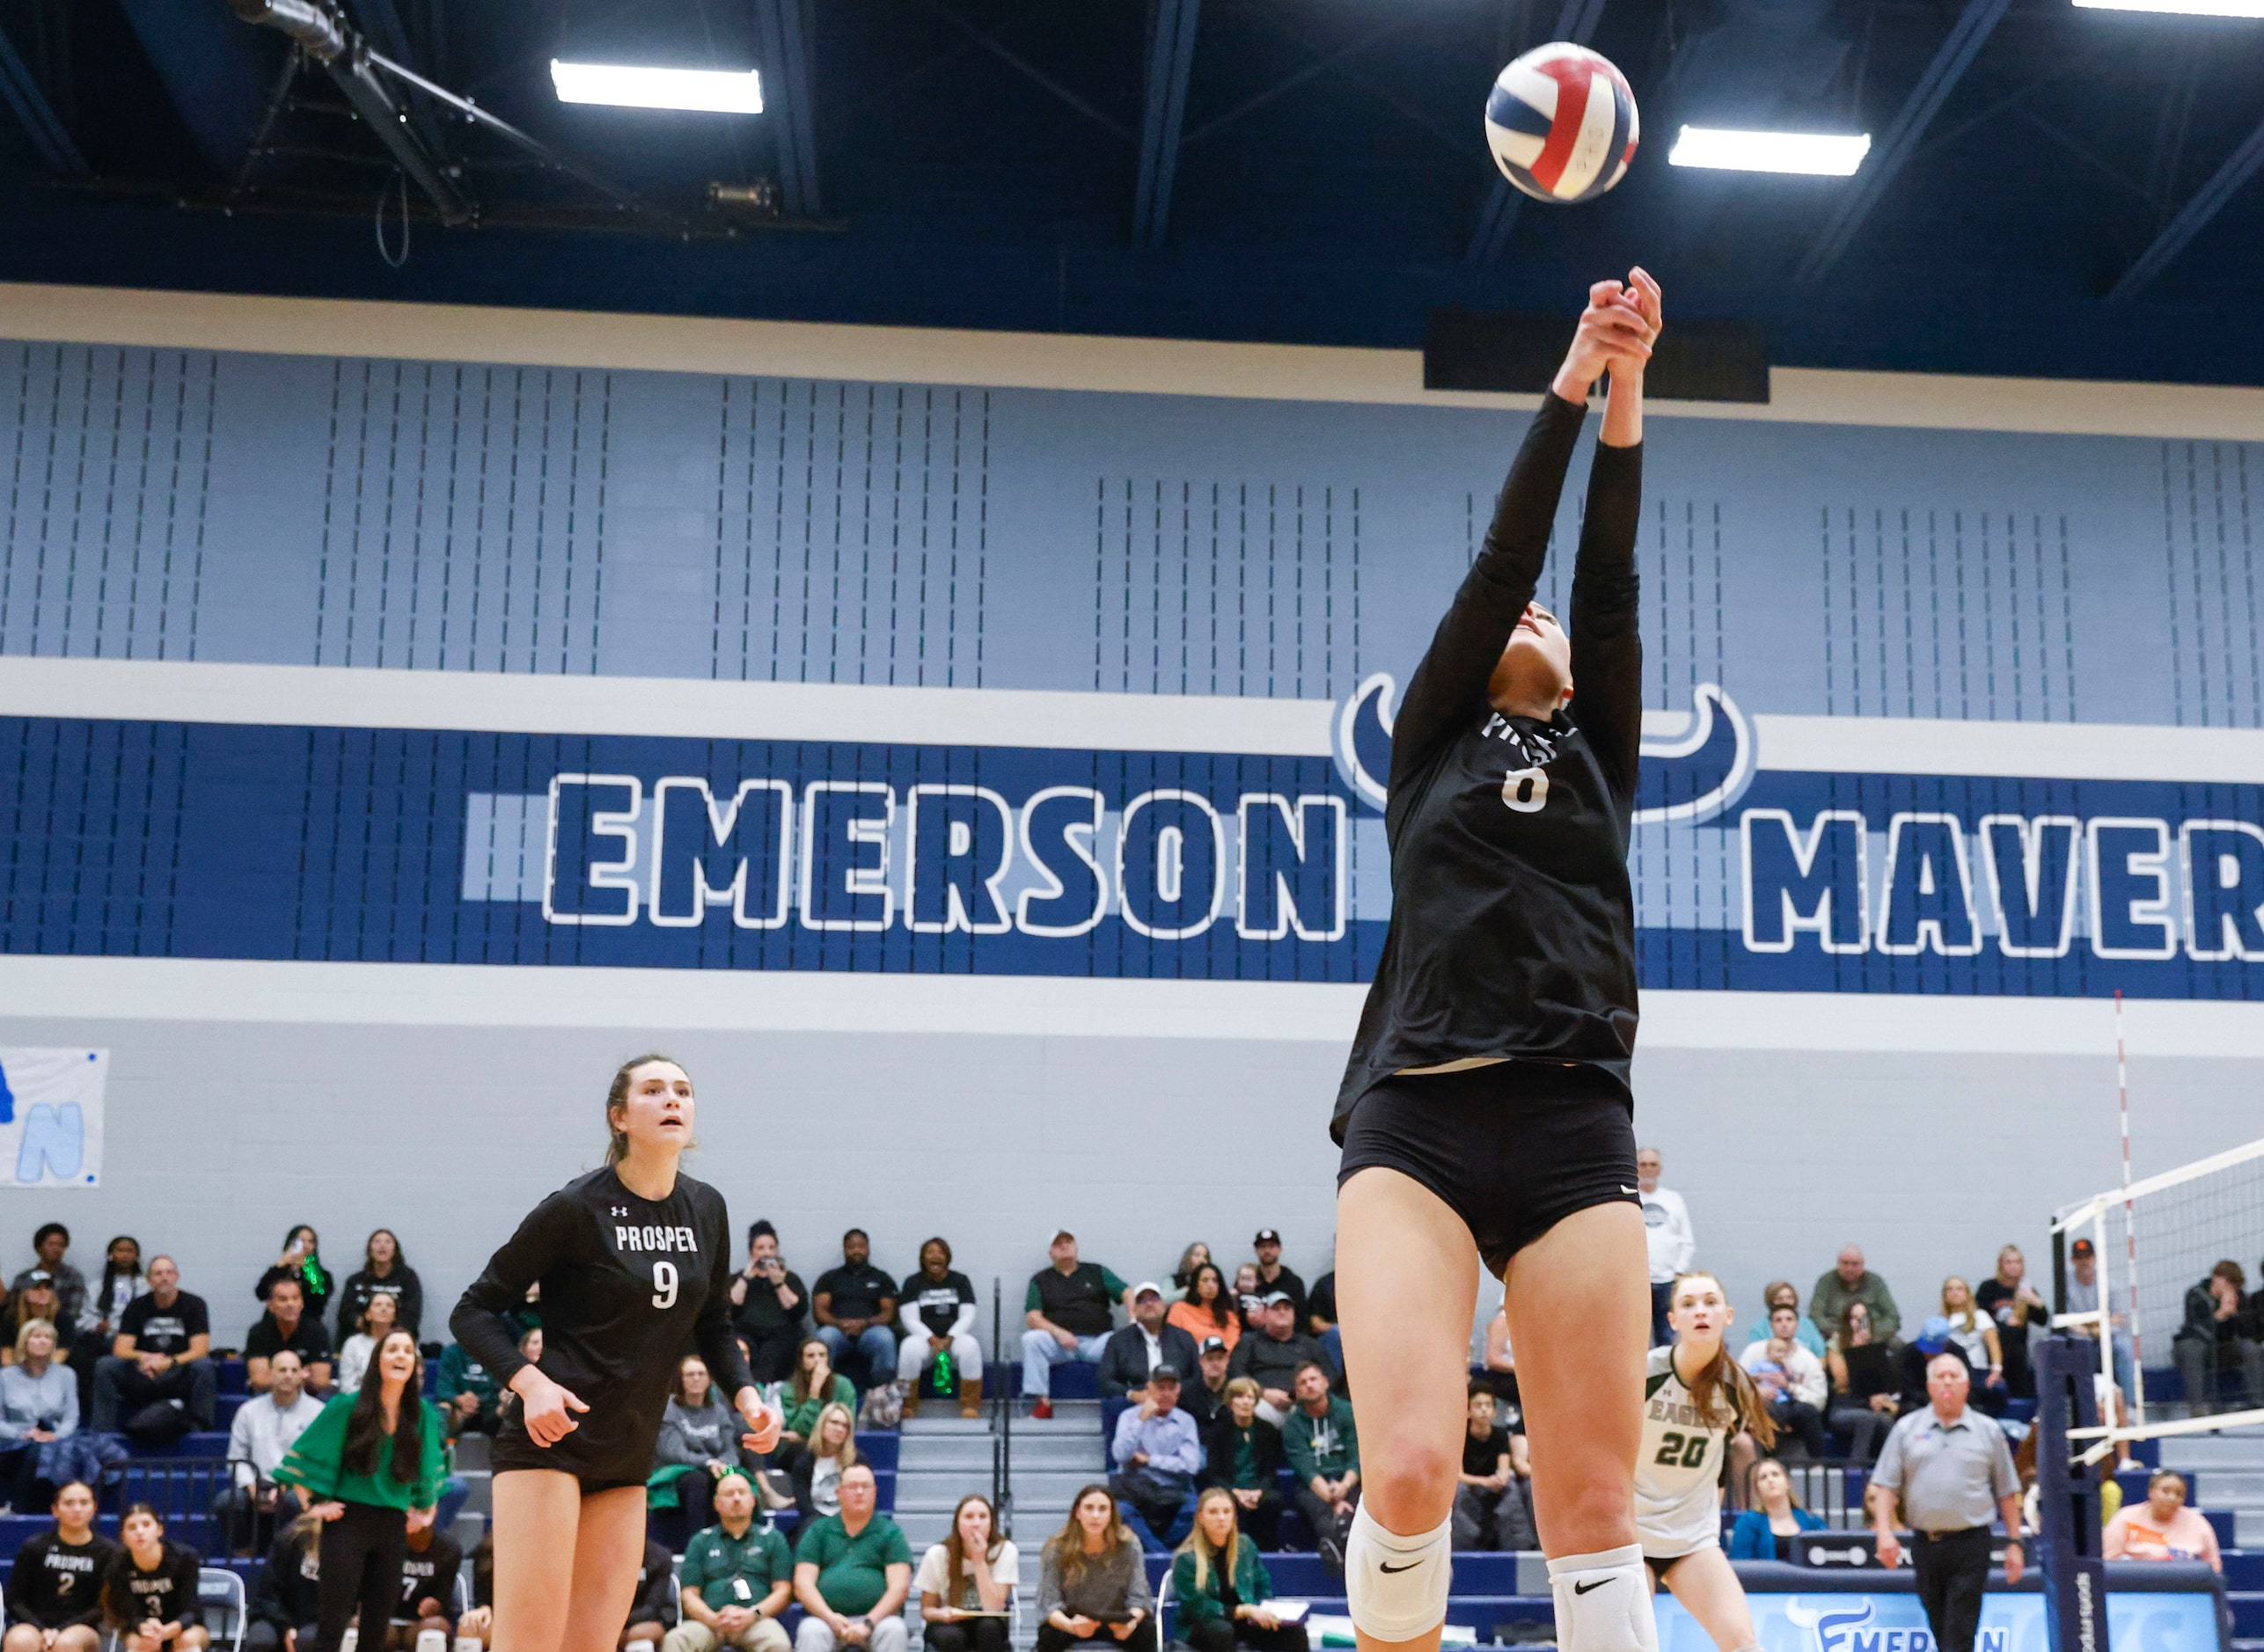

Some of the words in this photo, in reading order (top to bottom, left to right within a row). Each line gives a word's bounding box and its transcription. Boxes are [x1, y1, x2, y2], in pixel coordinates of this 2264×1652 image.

[542, 773, 1346, 943] EMERSON
[1740, 808, 2264, 962] MAVER
[615, 1225, 699, 1253] PROSPER
[652, 1261, 679, 1310] 9
[1654, 1431, 1709, 1468] 20
[56, 1572, 76, 1597] 2
[401, 1576, 419, 1602] 7
